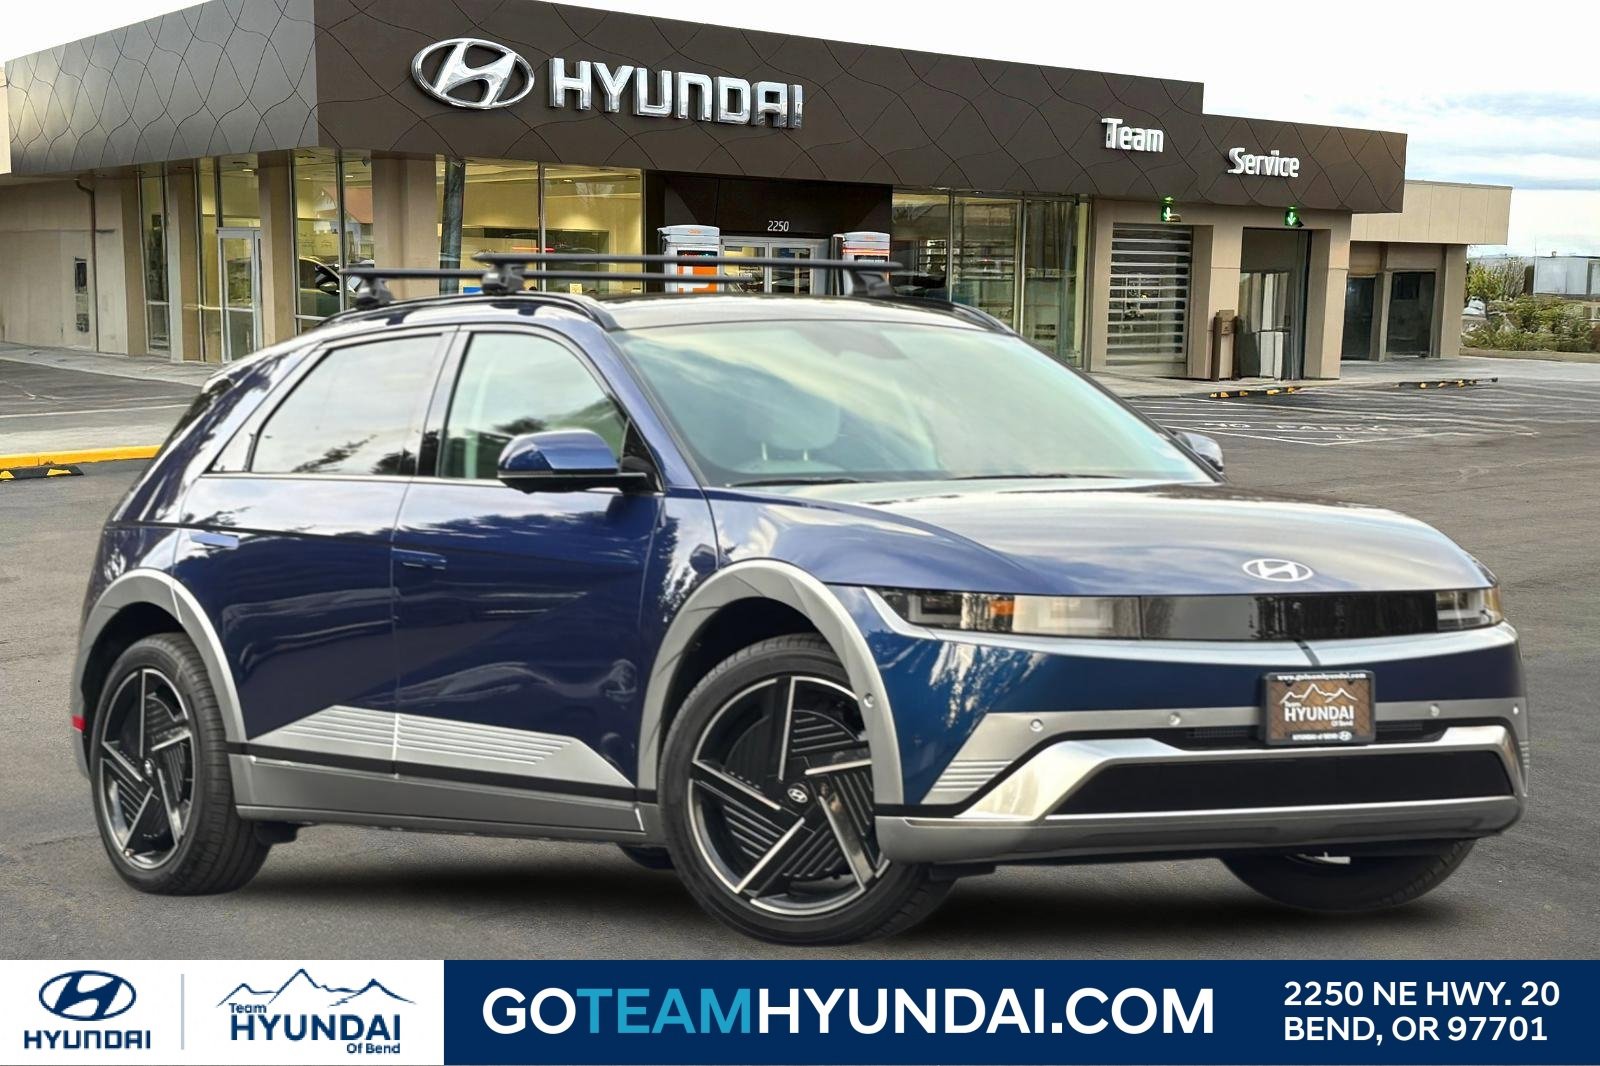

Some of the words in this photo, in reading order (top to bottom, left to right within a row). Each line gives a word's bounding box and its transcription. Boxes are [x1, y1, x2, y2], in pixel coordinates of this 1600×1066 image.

[548, 57, 803, 129] HYUNDAI
[1102, 117, 1164, 152] Team
[1227, 146, 1300, 178] Service
[767, 220, 790, 232] 2250
[1284, 705, 1354, 722] HYUNDAI
